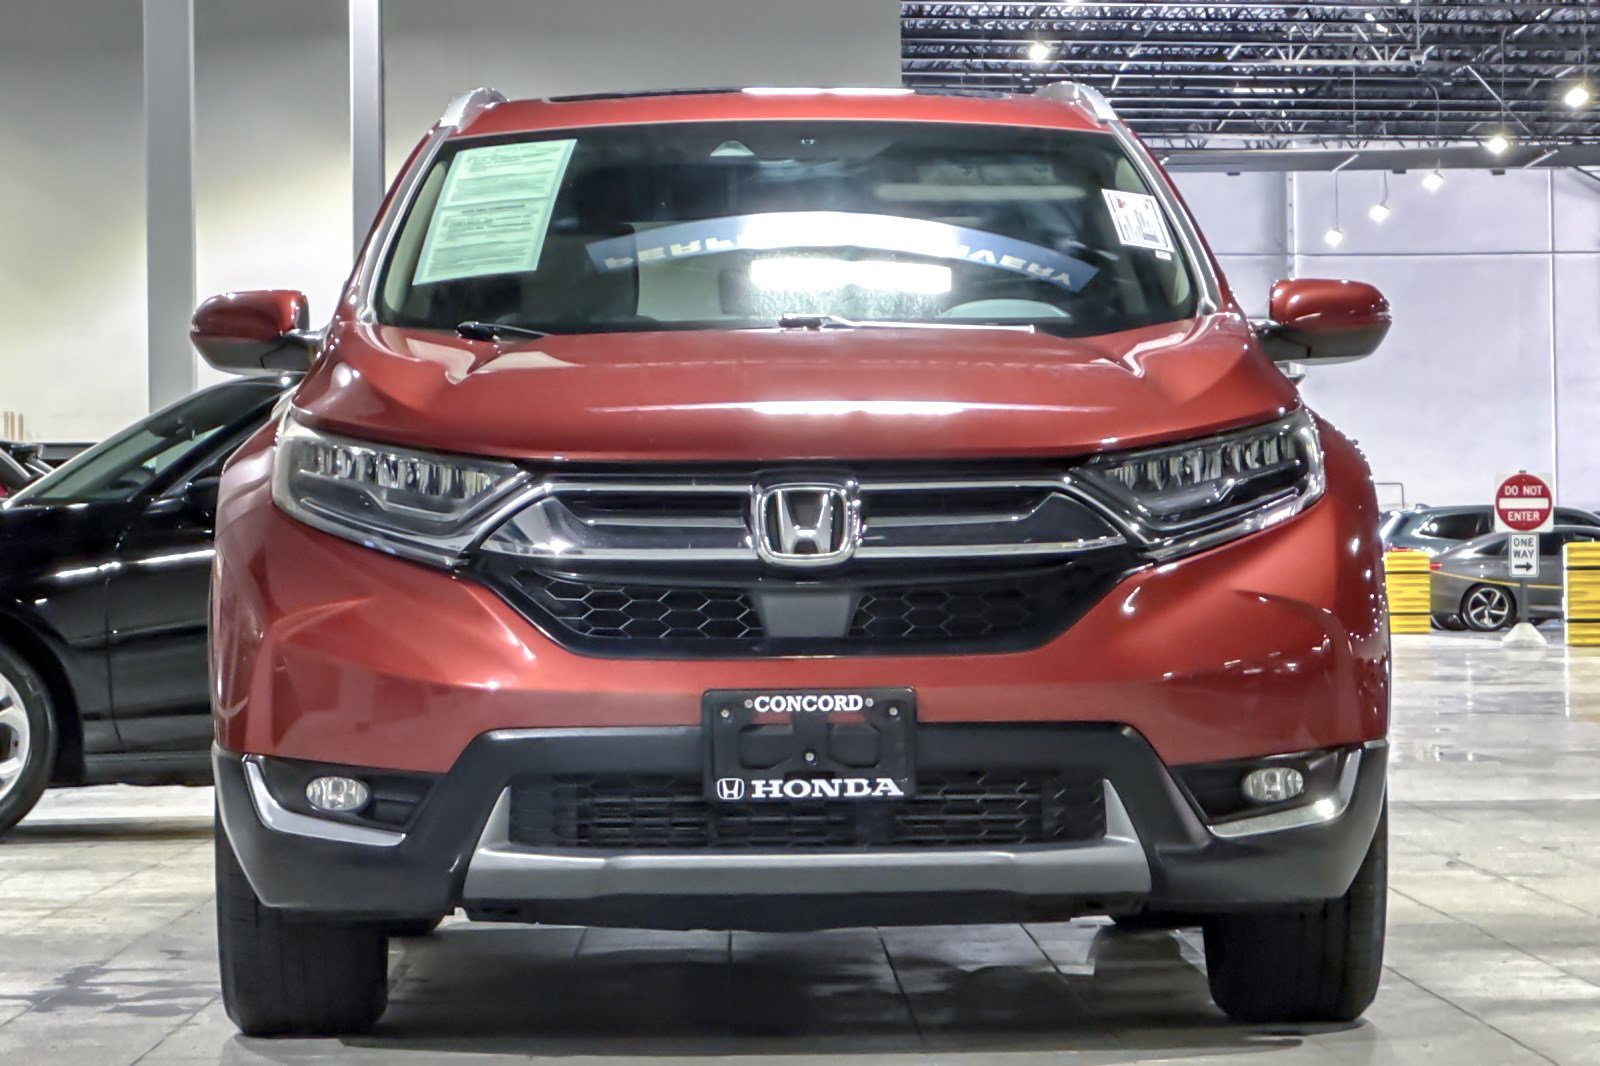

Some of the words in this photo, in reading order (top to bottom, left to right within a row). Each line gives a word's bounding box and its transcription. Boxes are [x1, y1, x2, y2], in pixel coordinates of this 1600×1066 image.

[1504, 485, 1519, 496] DO
[1522, 485, 1542, 496] NOT
[1507, 511, 1540, 521] ENTER
[1513, 537, 1534, 547] ONE
[1513, 549, 1535, 559] WAY
[754, 694, 864, 713] CONCORD
[751, 777, 904, 798] HONDA
